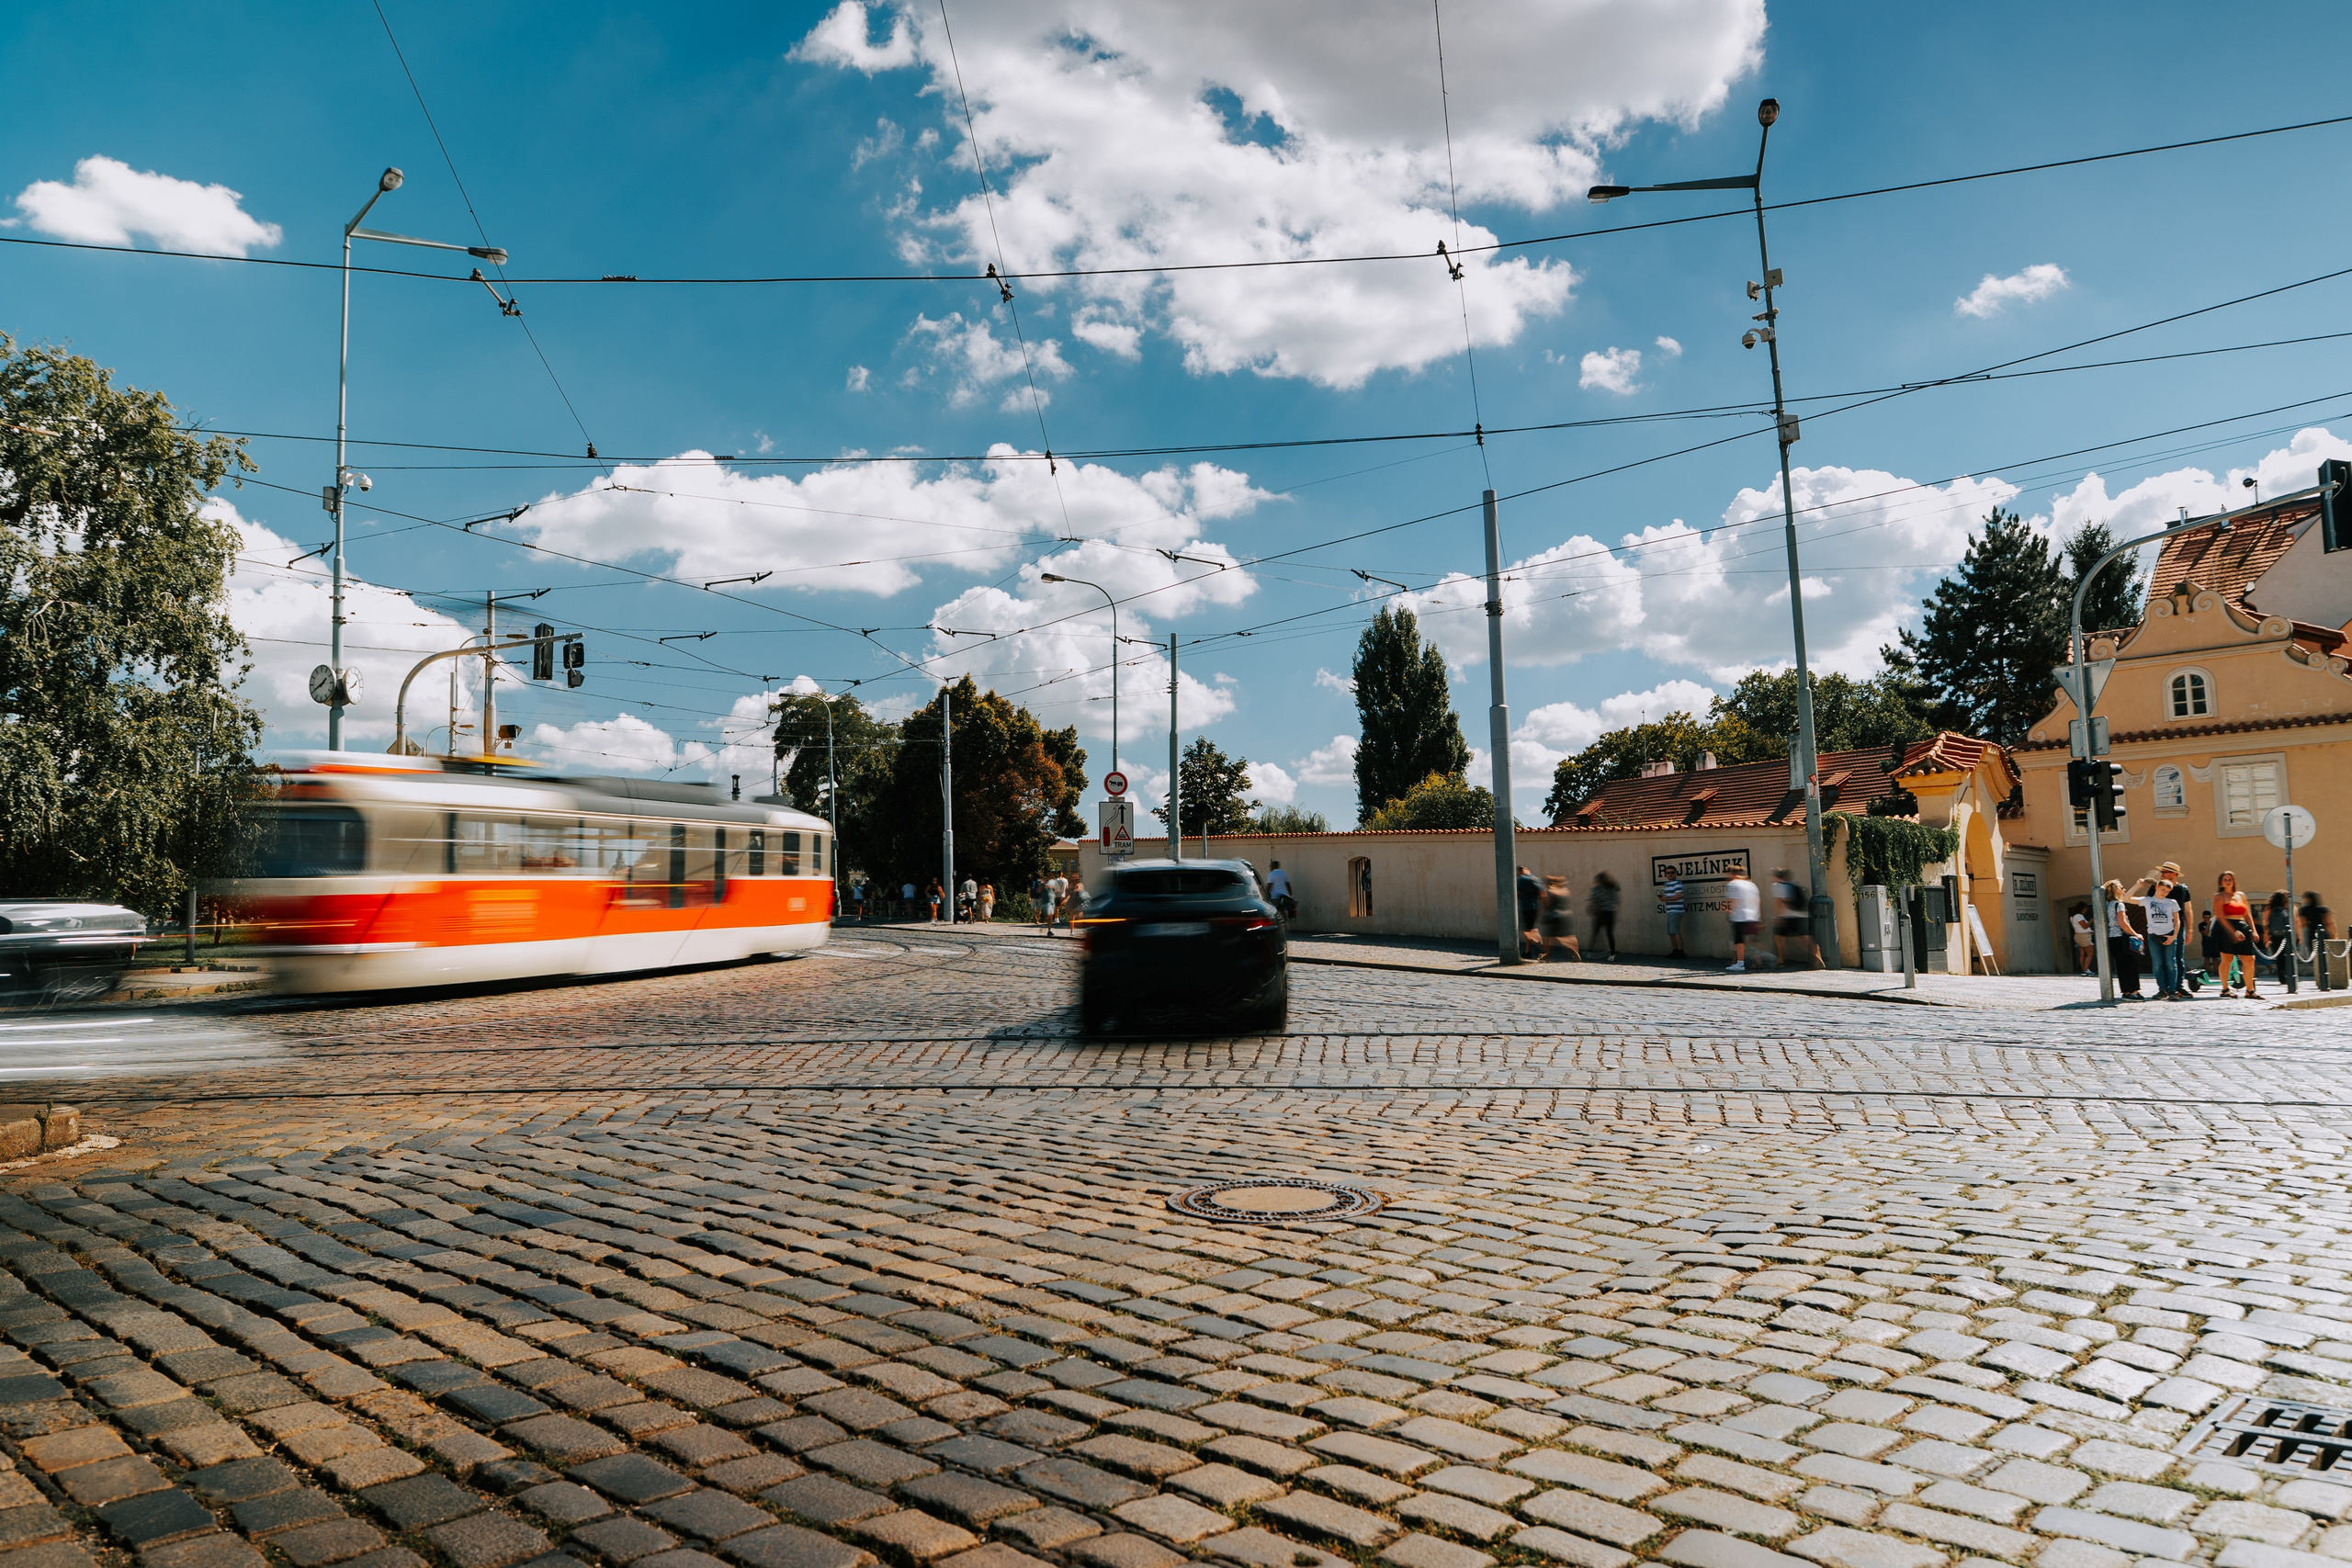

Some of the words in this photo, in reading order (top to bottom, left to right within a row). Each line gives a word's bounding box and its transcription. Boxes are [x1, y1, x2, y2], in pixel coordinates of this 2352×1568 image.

[1686, 886, 1709, 896] CZECH
[1860, 891, 1876, 899] 156
[1657, 902, 1704, 914] SLVITZ
[1705, 900, 1734, 912] MUSE
